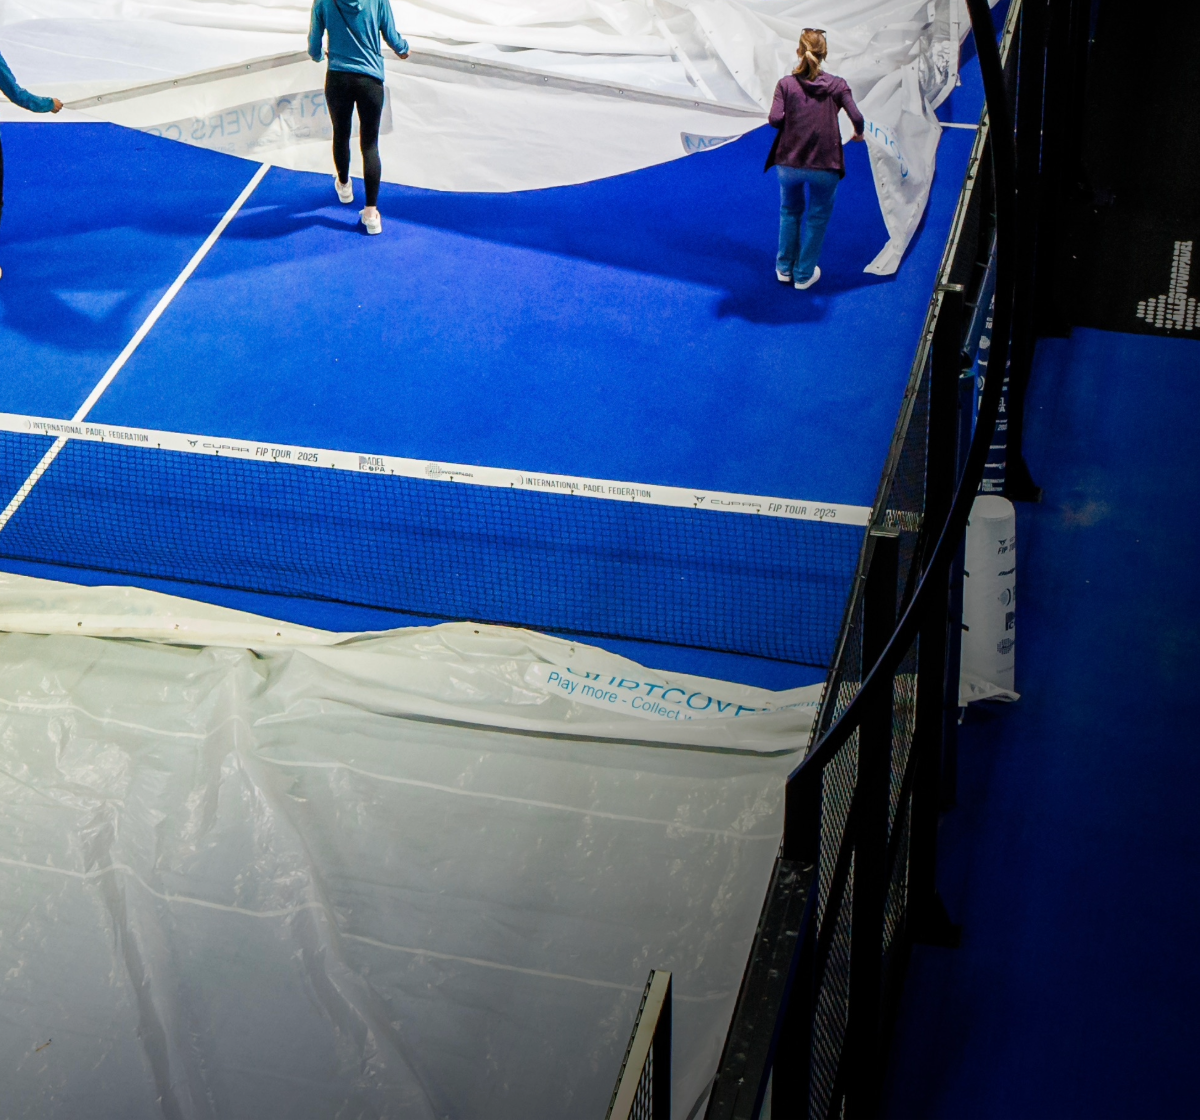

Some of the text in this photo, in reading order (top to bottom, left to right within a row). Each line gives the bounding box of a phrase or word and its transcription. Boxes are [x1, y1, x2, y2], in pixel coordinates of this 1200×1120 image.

[33, 421, 149, 443] INTERNATIONAL PADEL FEDERATION
[255, 447, 319, 463] FIP TOUR 2025
[525, 476, 652, 499] INTERNATIONAL PADEL FEDERATION
[768, 501, 837, 519] FIP TOUR 2025
[547, 671, 578, 695] Play
[581, 683, 618, 704] more
[631, 695, 680, 721] Collect
